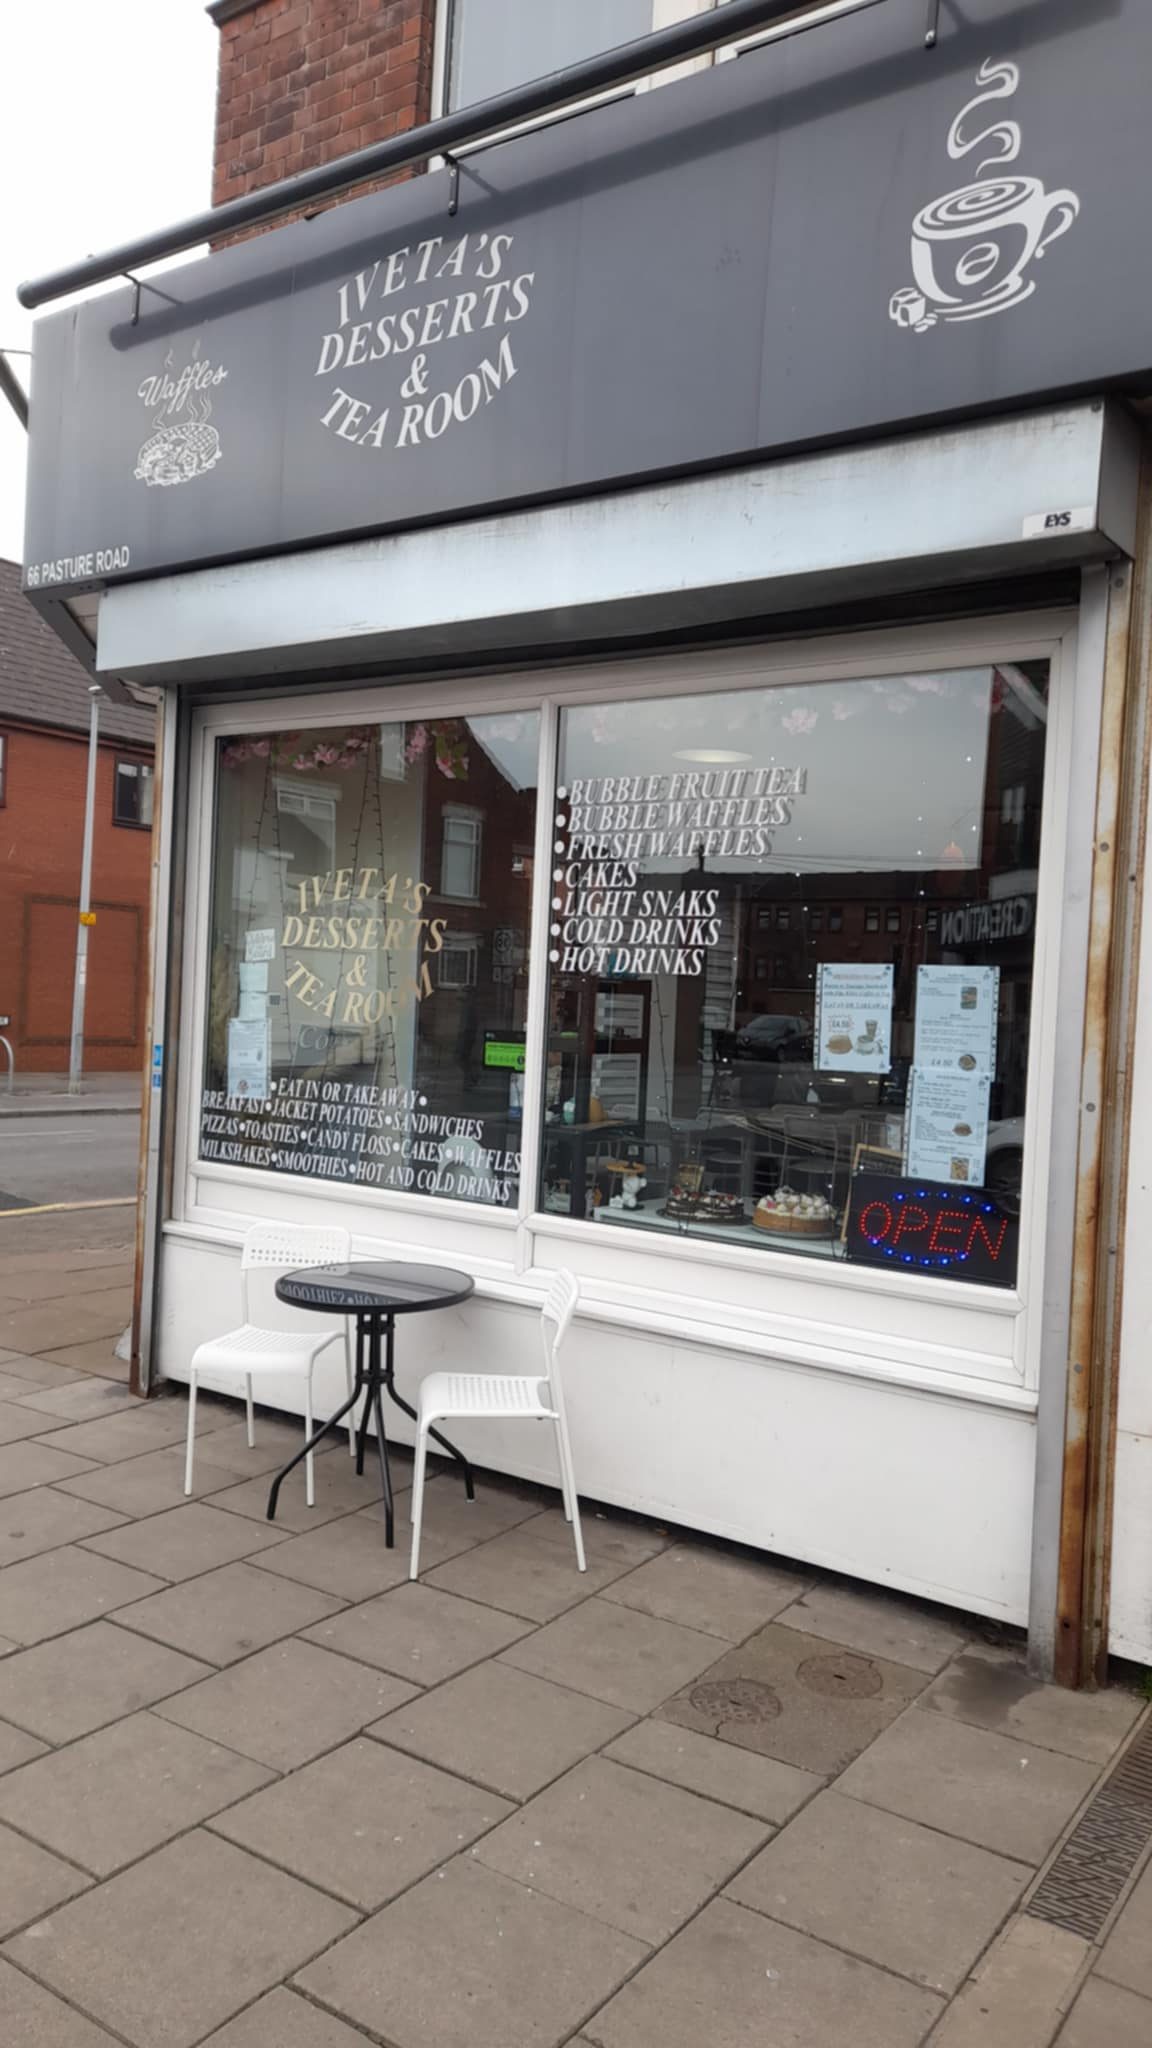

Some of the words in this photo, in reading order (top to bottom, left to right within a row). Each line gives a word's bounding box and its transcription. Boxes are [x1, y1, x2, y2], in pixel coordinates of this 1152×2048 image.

[337, 233, 514, 329] IVETA'S
[314, 272, 535, 376] DESSERTS
[137, 359, 228, 414] Waffles
[320, 387, 390, 448] TEA
[395, 332, 519, 448] ROOM
[400, 353, 430, 399] &
[1044, 510, 1072, 528] EYS
[27, 565, 40, 587] 66
[41, 553, 93, 583] PASTURE
[95, 545, 130, 573] ROAD
[568, 774, 661, 805] BUBBLE
[669, 769, 747, 799] FRUIT
[753, 766, 800, 795] TEA
[567, 802, 660, 832] BUBBLE
[667, 796, 789, 829] WAFFLES
[566, 832, 642, 860] FRESH
[650, 828, 768, 857] WAFFLES
[299, 867, 432, 915] IVETA'S
[565, 862, 639, 888] CAKES
[562, 890, 637, 917] LIGHT
[638, 889, 720, 917] SNAKS
[280, 915, 448, 953] DESSERTS
[562, 918, 625, 944] COLD
[628, 918, 722, 946] DRINKS
[345, 954, 368, 987] &
[560, 946, 610, 973] HOT
[613, 948, 704, 976] DRINKS
[284, 960, 338, 1019] TEA
[278, 1077, 304, 1098] EAT
[304, 1080, 321, 1099] IN
[321, 1081, 341, 1102] OR
[202, 1089, 265, 1115] BREAKFAST
[271, 1098, 318, 1121] JACKET
[319, 1103, 384, 1129] POTATOES
[391, 1111, 484, 1141] SANDWICHES
[201, 1113, 239, 1136] PIZZAS
[244, 1119, 300, 1144] TOASTIES
[307, 1127, 351, 1151] CANDY
[351, 1133, 392, 1157] FLOSS
[401, 1138, 445, 1164] CAKES
[453, 1145, 521, 1174] WAFFLES
[201, 1138, 271, 1167] MILKSHAKES
[275, 1149, 349, 1178] SMOOTHIES
[356, 1161, 385, 1182] HOT
[385, 1163, 415, 1187] AND
[417, 1168, 454, 1193] COLD
[457, 1174, 512, 1201] DRINKS
[858, 1201, 1008, 1262] OPEN
